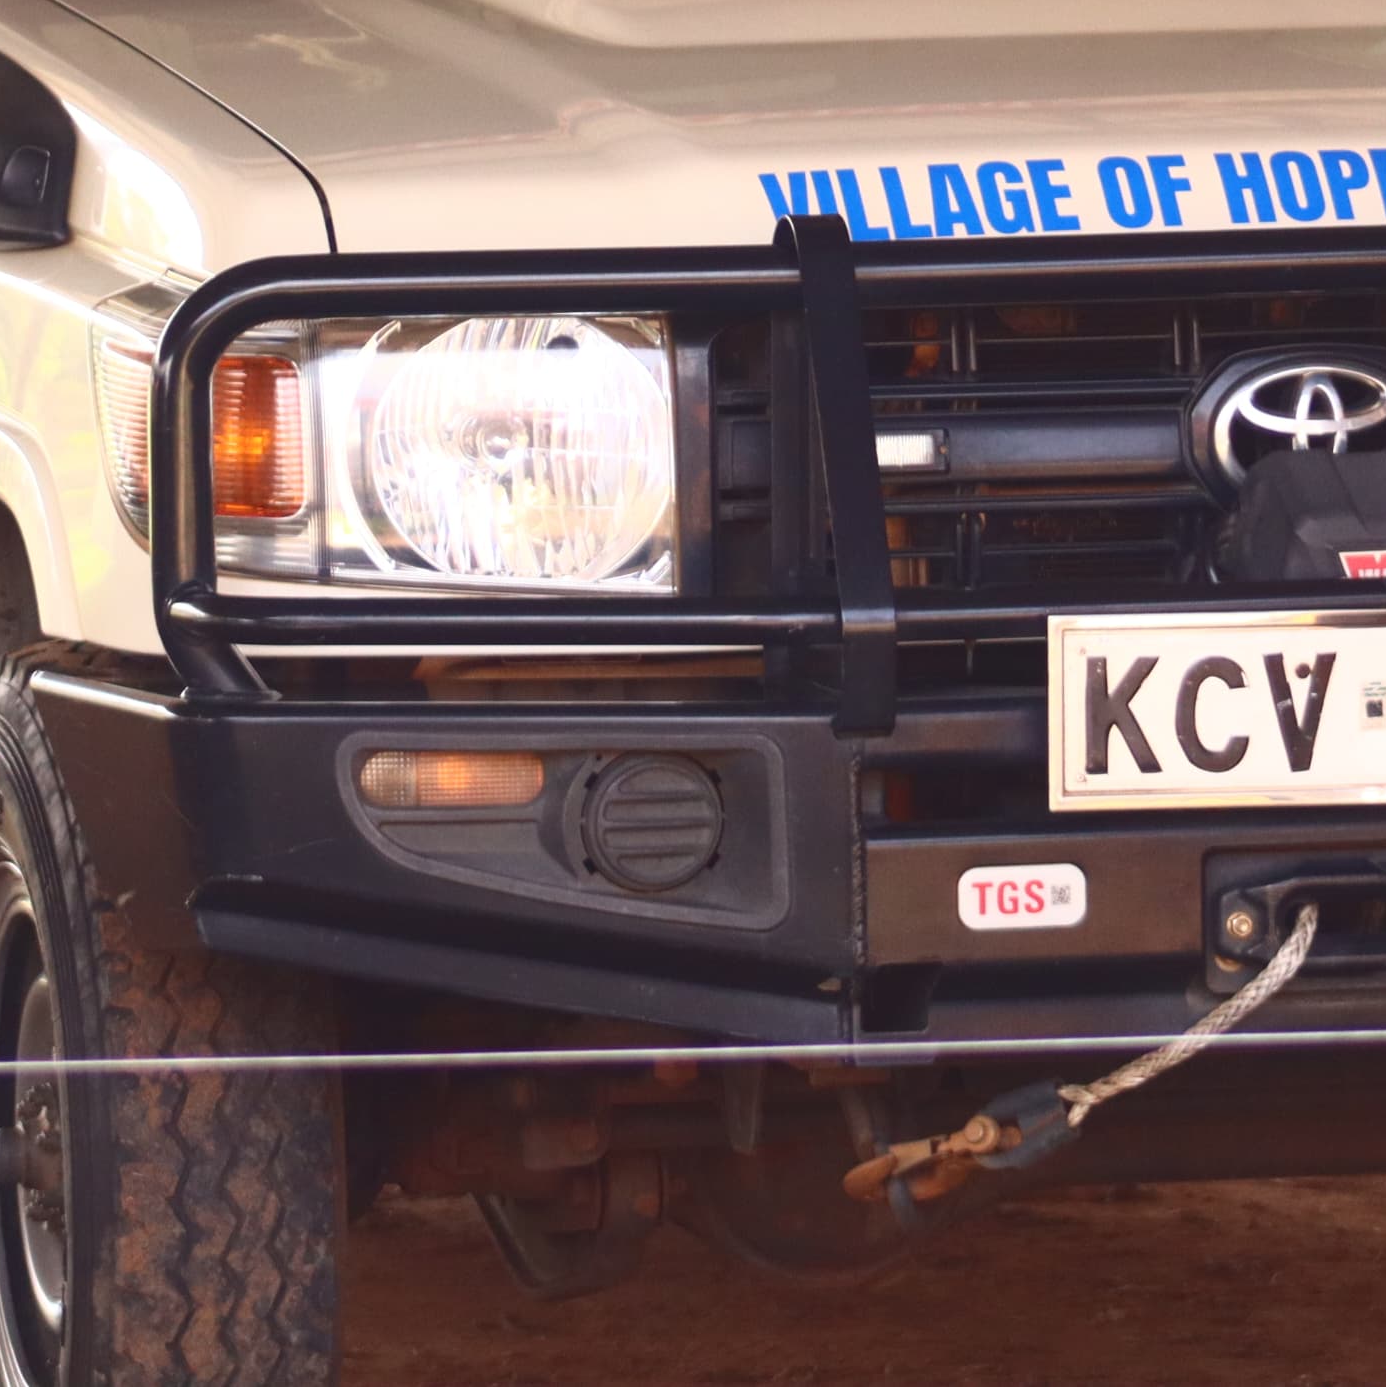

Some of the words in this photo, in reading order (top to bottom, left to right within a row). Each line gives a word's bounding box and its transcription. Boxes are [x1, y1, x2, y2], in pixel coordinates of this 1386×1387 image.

[759, 159, 1081, 243] VILLAGE
[1096, 155, 1192, 230] OF
[1084, 653, 1337, 774] KCV
[971, 879, 1045, 916] TGS
